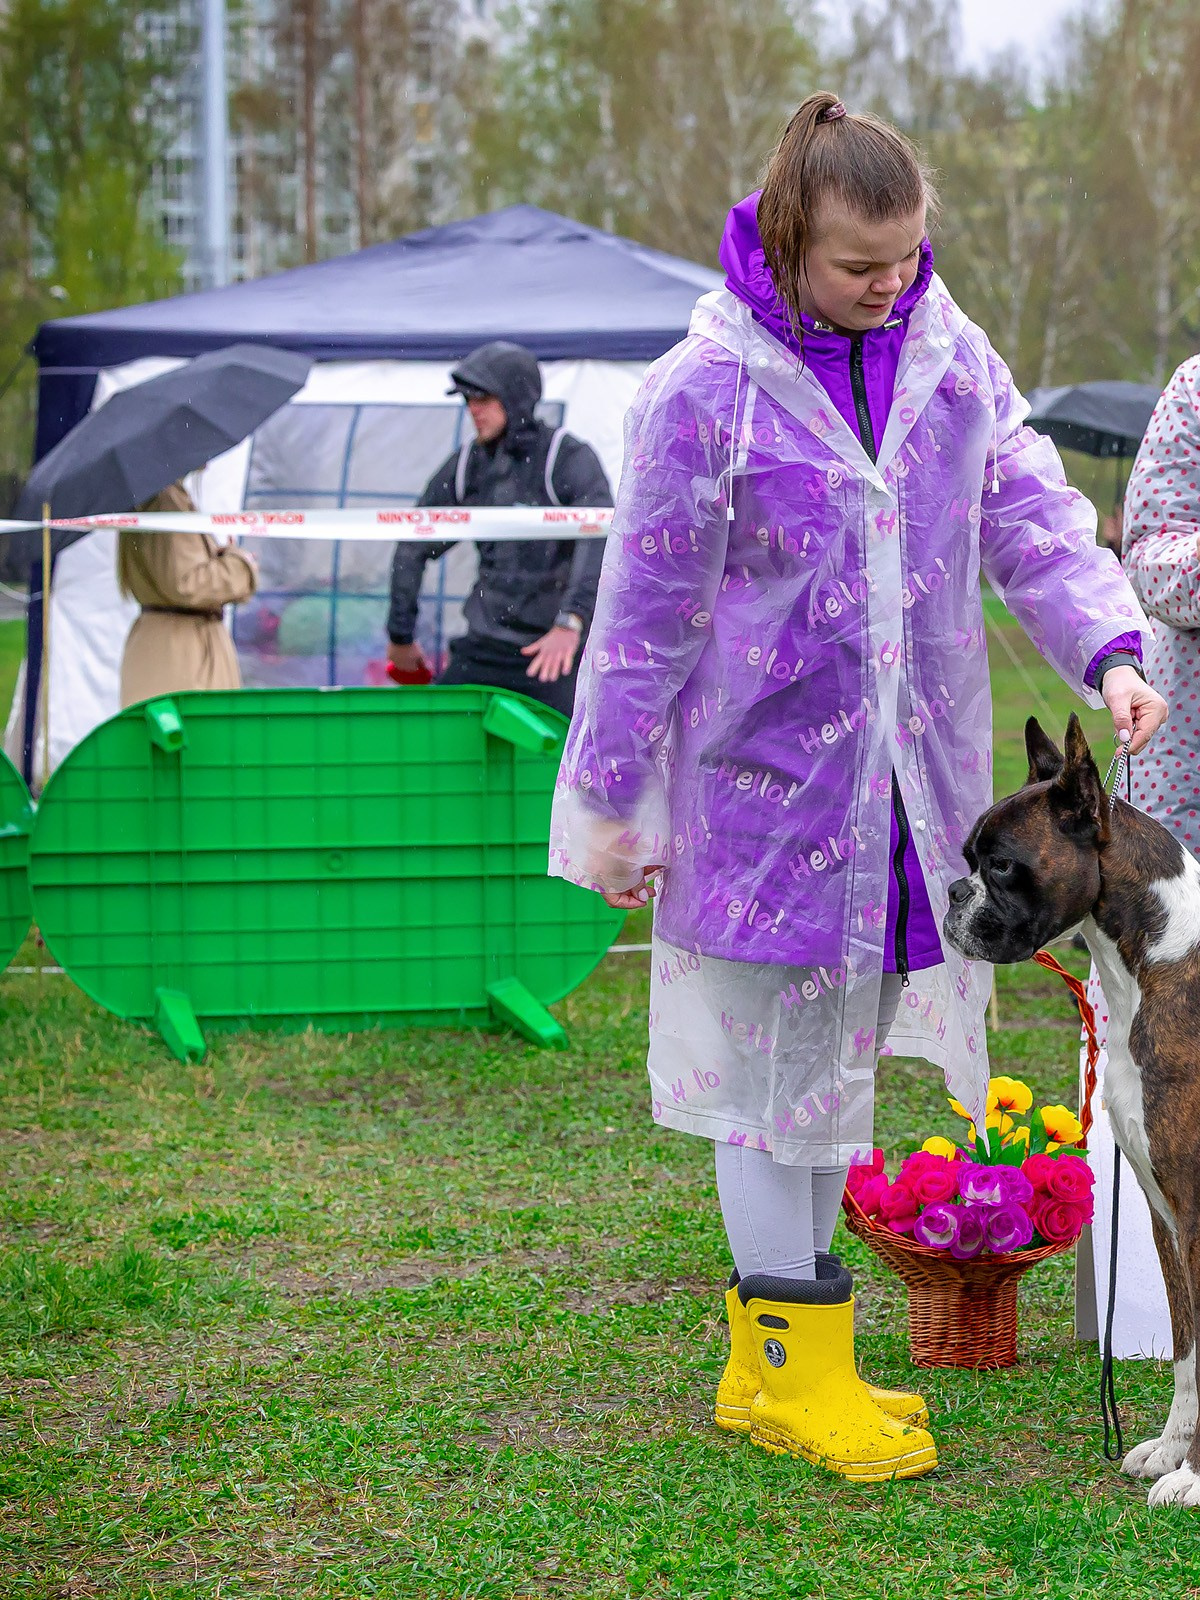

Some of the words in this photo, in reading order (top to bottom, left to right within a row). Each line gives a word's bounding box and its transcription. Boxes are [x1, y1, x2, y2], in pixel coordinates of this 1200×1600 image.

[807, 568, 879, 629] Hello!
[798, 697, 877, 755] Hello!
[717, 761, 798, 807] Hello!
[788, 826, 866, 881] Hello!
[779, 955, 858, 1010] Hello!
[774, 1080, 850, 1135] Hello!
